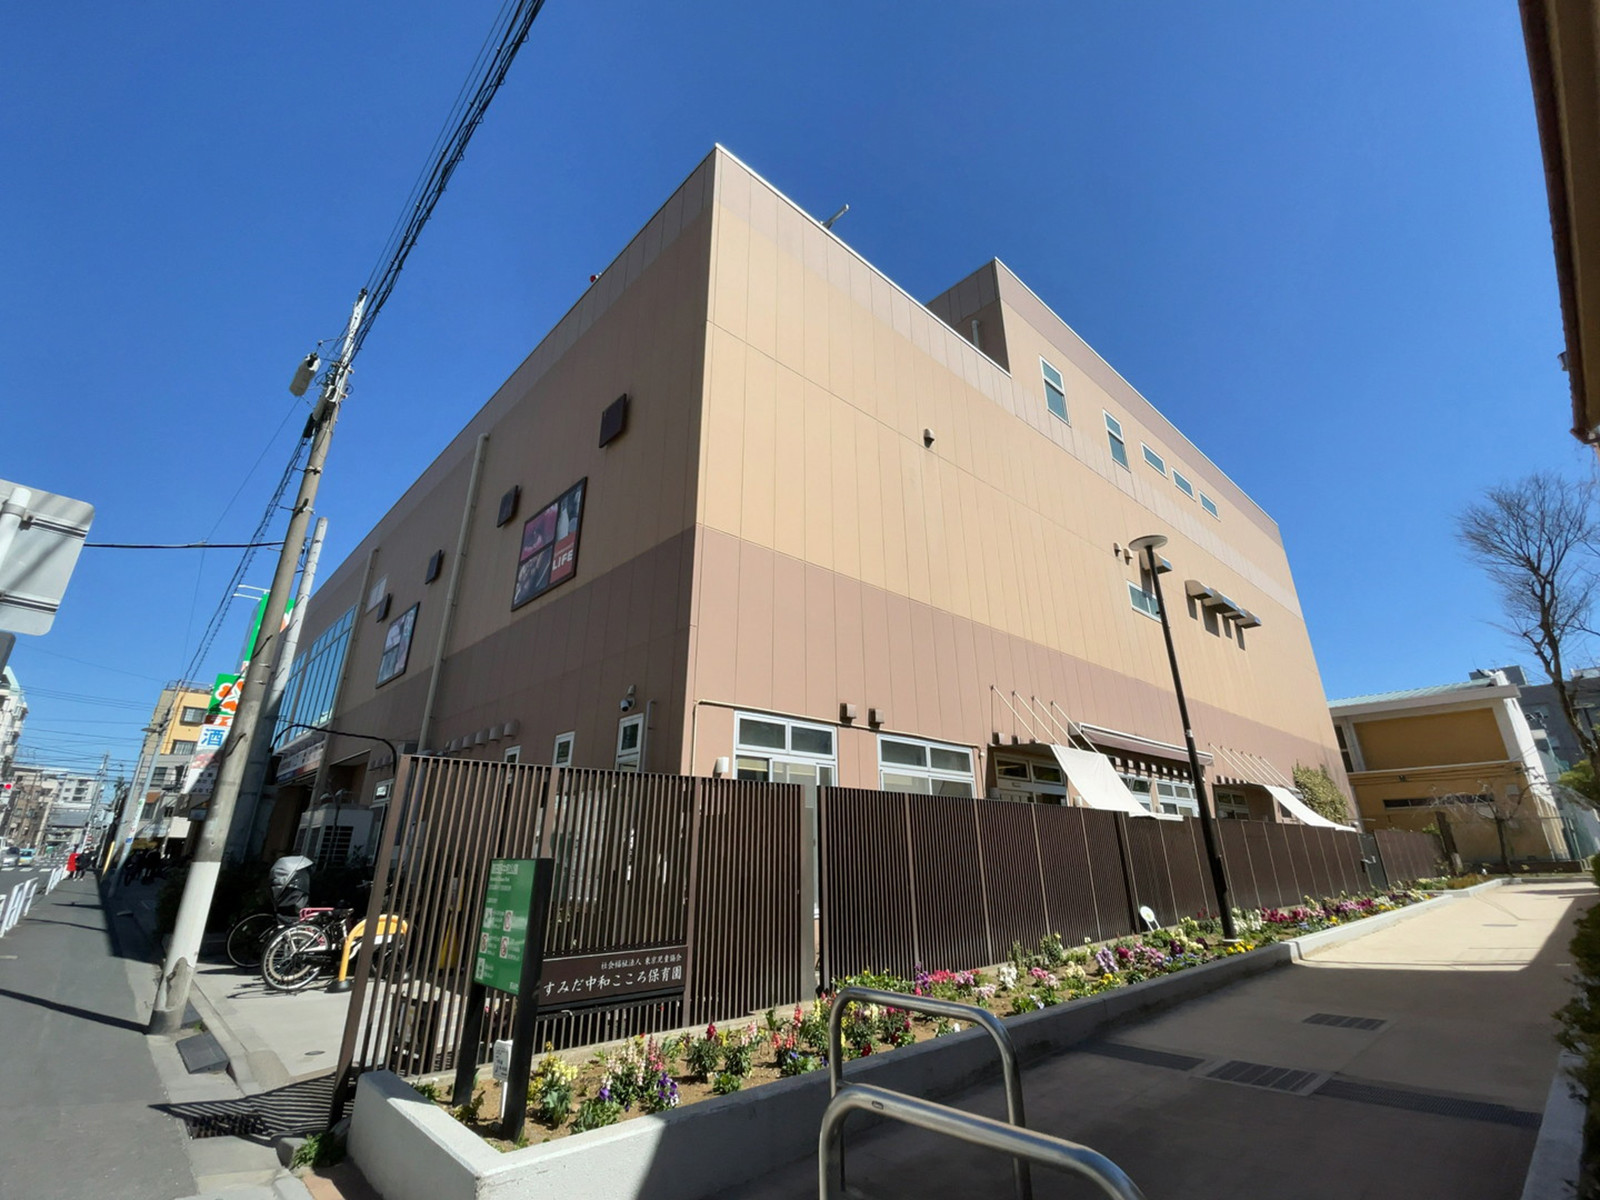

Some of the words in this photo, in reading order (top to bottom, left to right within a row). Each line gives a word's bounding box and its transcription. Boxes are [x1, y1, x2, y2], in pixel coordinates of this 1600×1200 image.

[552, 549, 573, 571] LIFE
[201, 728, 225, 746] 酒
[601, 958, 642, 970] 社会福祉法人
[543, 965, 682, 996] すみだ中和こころ保育園
